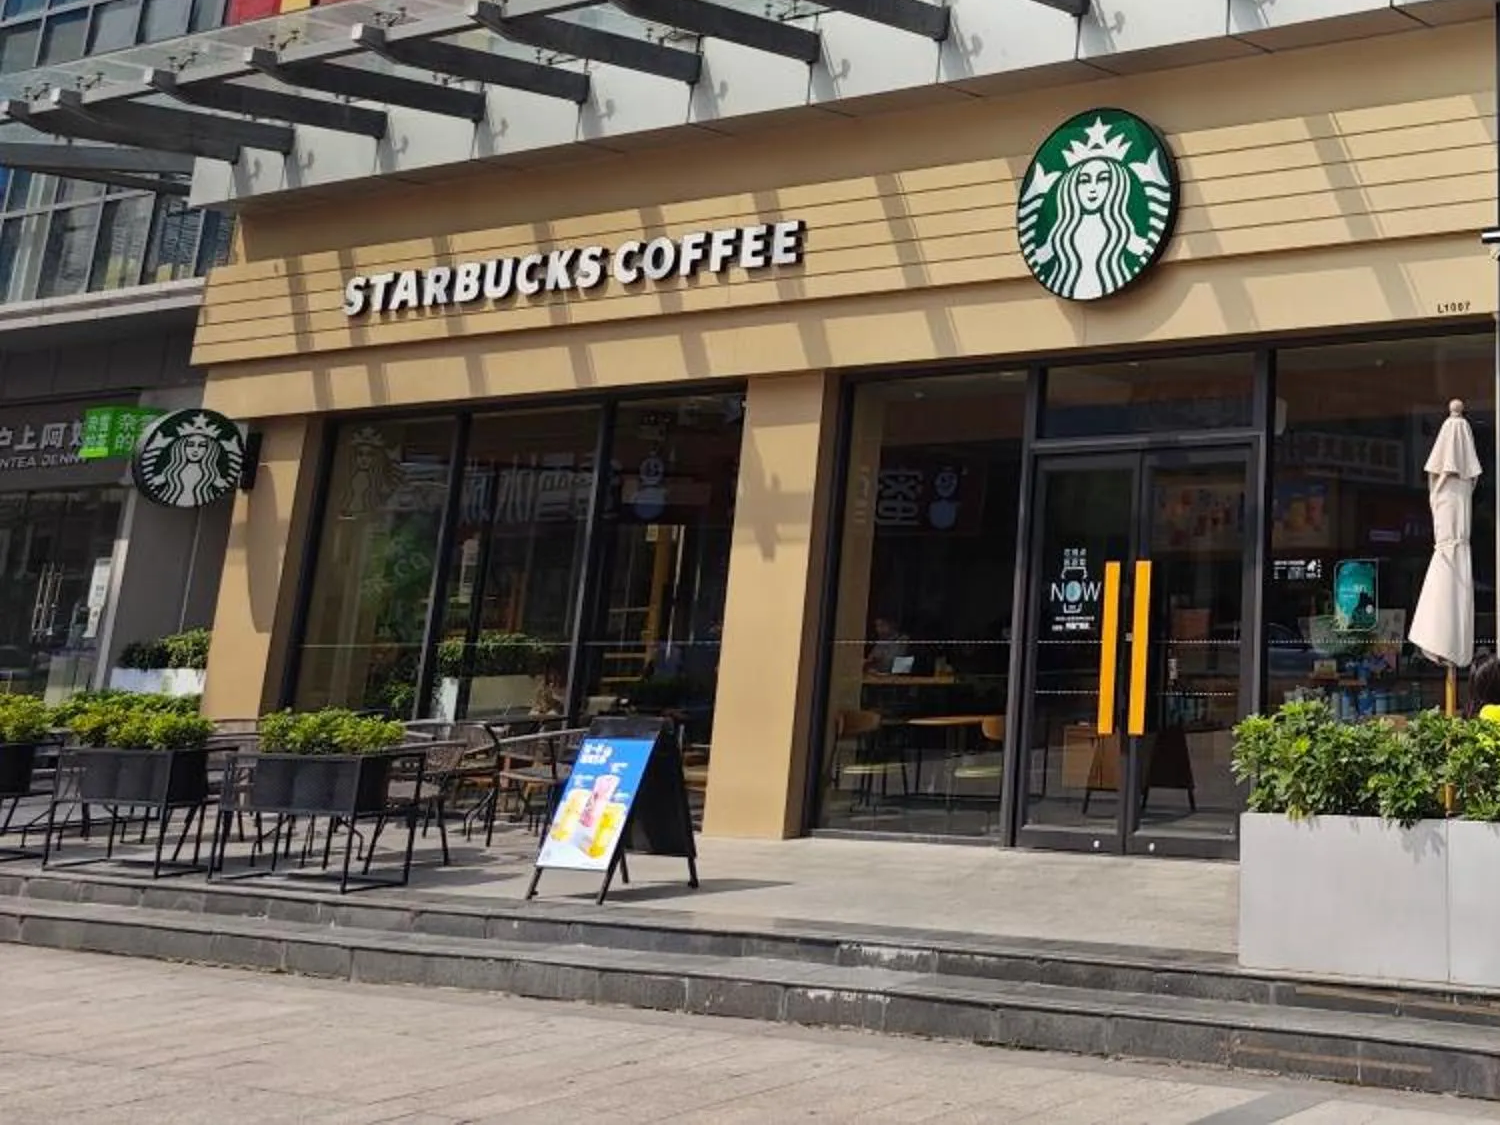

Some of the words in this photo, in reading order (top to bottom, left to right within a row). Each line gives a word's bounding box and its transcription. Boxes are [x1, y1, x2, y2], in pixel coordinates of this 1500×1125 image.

[342, 246, 604, 317] STARBUCKS
[613, 221, 801, 284] COFFEE
[1050, 580, 1102, 603] NOW
